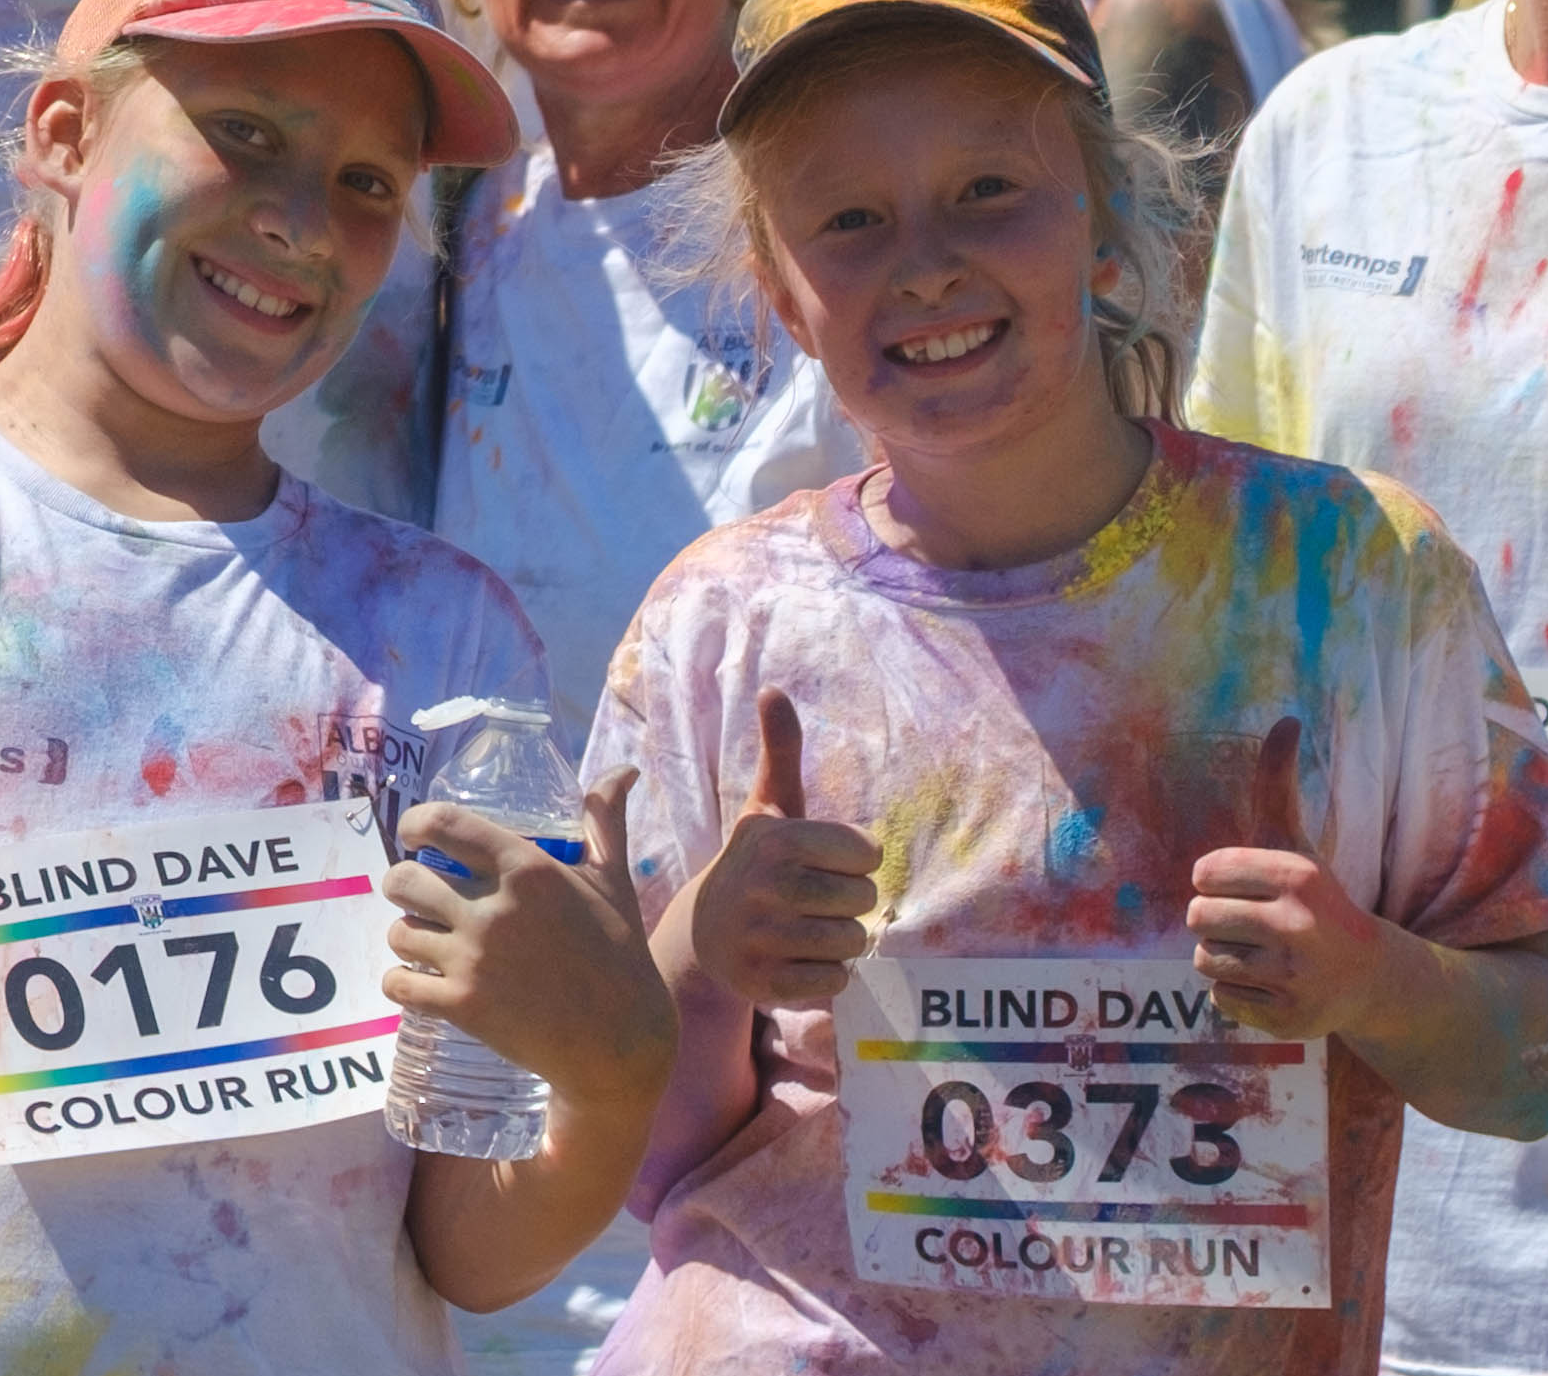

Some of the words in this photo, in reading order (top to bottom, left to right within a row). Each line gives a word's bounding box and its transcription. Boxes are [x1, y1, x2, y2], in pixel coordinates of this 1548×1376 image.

[156, 836, 300, 886] DAVE
[2, 922, 338, 1052] 0176
[921, 989, 1079, 1029] BLIND
[24, 1076, 253, 1135] COLOUR
[271, 1050, 385, 1104] RUN
[920, 1079, 1243, 1186] 0373
[914, 1227, 1132, 1275] COLOUR
[1149, 1236, 1260, 1278] RUN
